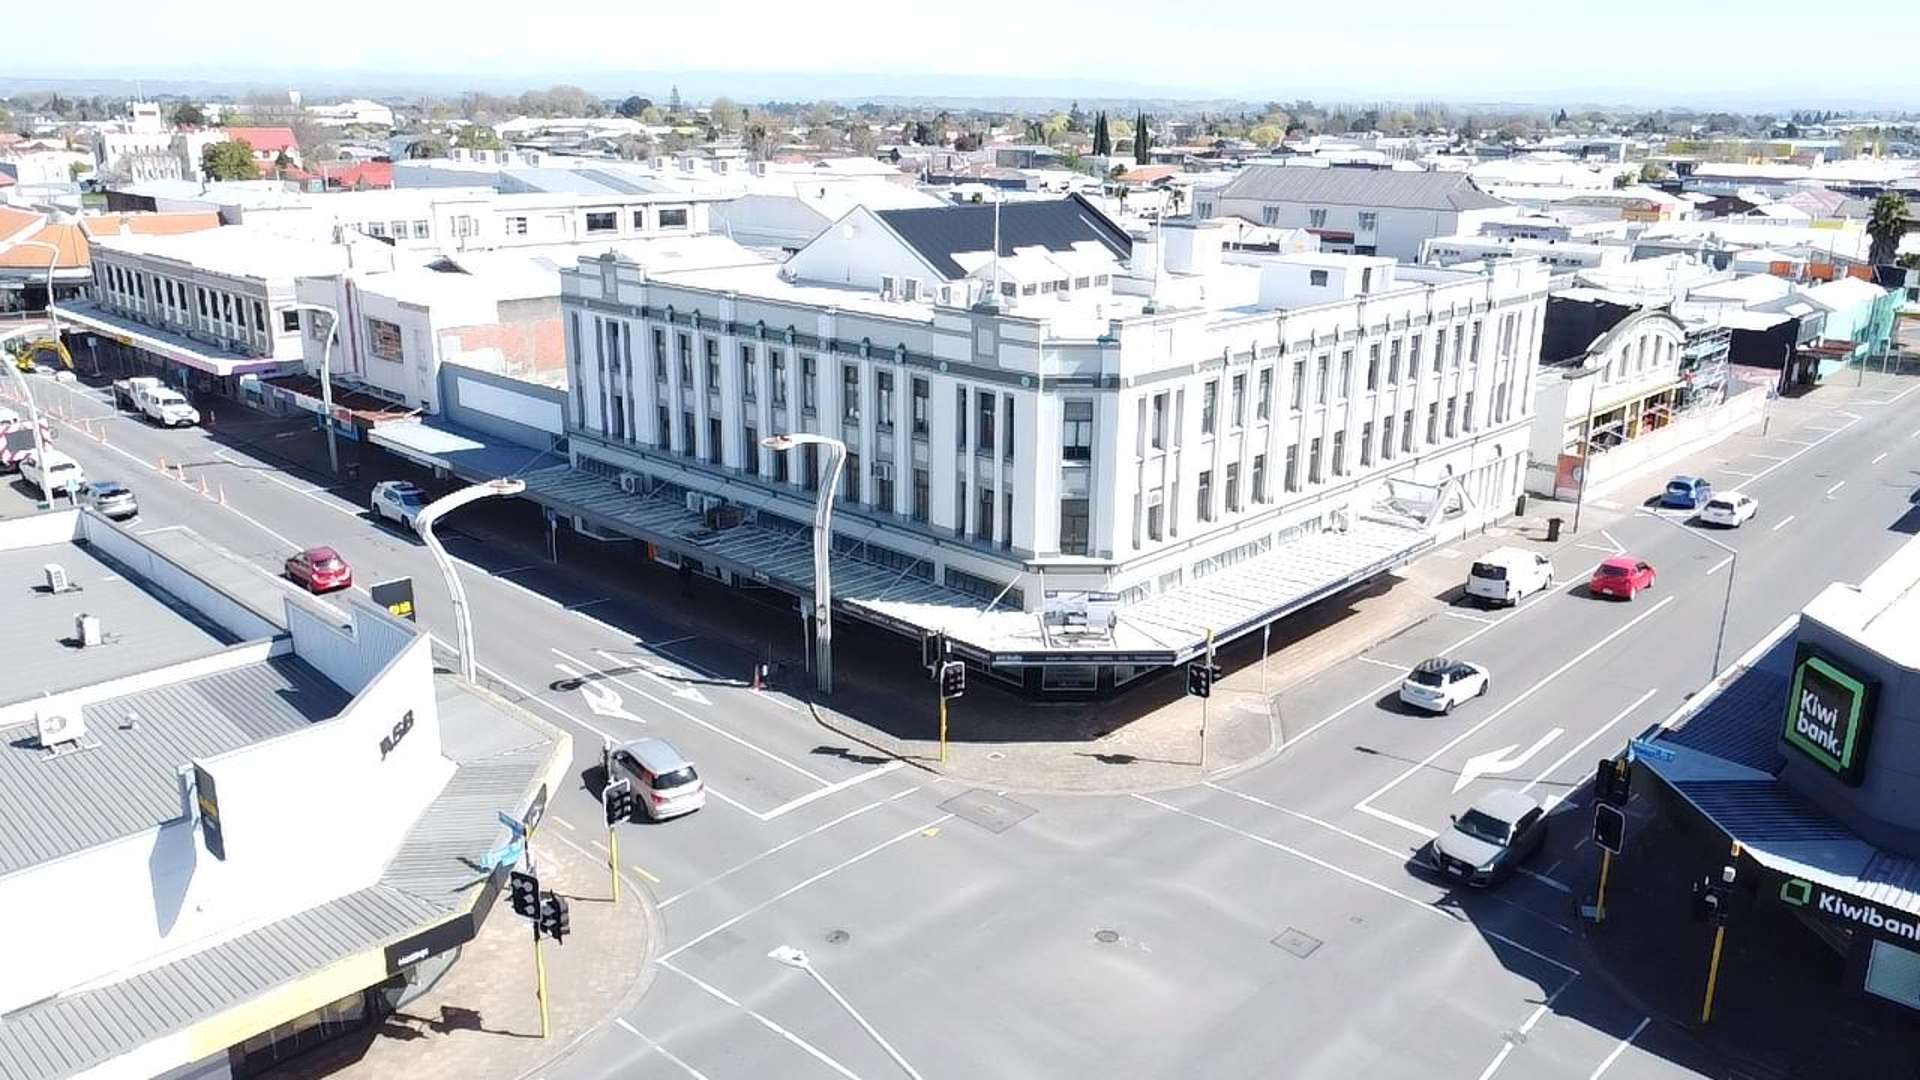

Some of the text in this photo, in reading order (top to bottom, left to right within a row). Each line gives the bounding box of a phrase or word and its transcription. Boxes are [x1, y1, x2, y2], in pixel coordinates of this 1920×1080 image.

[1801, 689, 1839, 729] Kiwi
[379, 709, 415, 762] ASB
[1797, 711, 1842, 757] bank.
